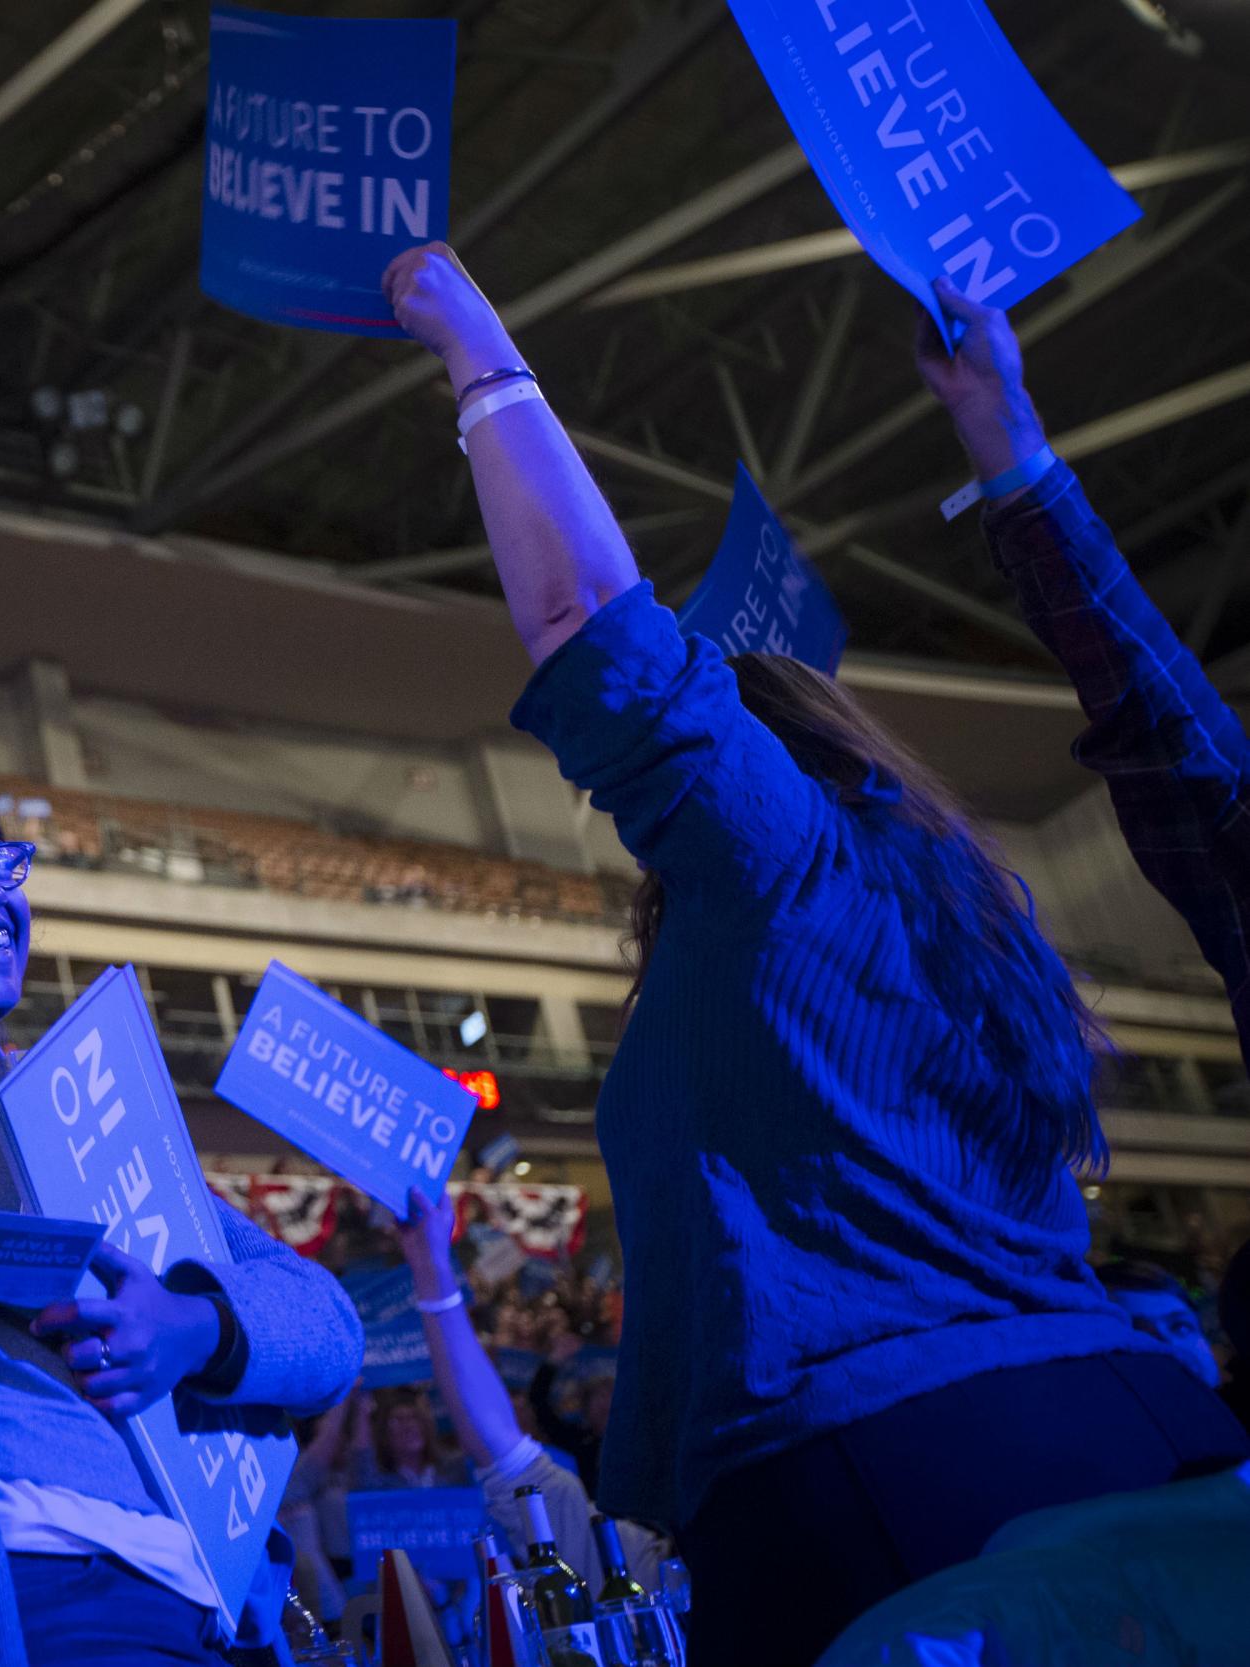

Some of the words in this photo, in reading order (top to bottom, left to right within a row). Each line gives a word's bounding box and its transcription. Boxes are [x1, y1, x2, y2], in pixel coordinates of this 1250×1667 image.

[225, 84, 341, 154] FUTURE
[353, 106, 432, 160] TO
[782, 34, 877, 220] BERNIESANDERS.COM
[208, 141, 346, 229] BELIEVE
[360, 176, 430, 239] IN
[983, 170, 1061, 259] TO
[927, 213, 1018, 305] IN
[754, 522, 779, 585] TO
[51, 1066, 95, 1182] TO
[73, 1027, 126, 1137] IN
[247, 1028, 398, 1148] BELIEVE
[400, 1132, 447, 1179] IN
[261, 1005, 284, 1031] A
[288, 1019, 408, 1115] FUTURE
[413, 1100, 456, 1145] TO
